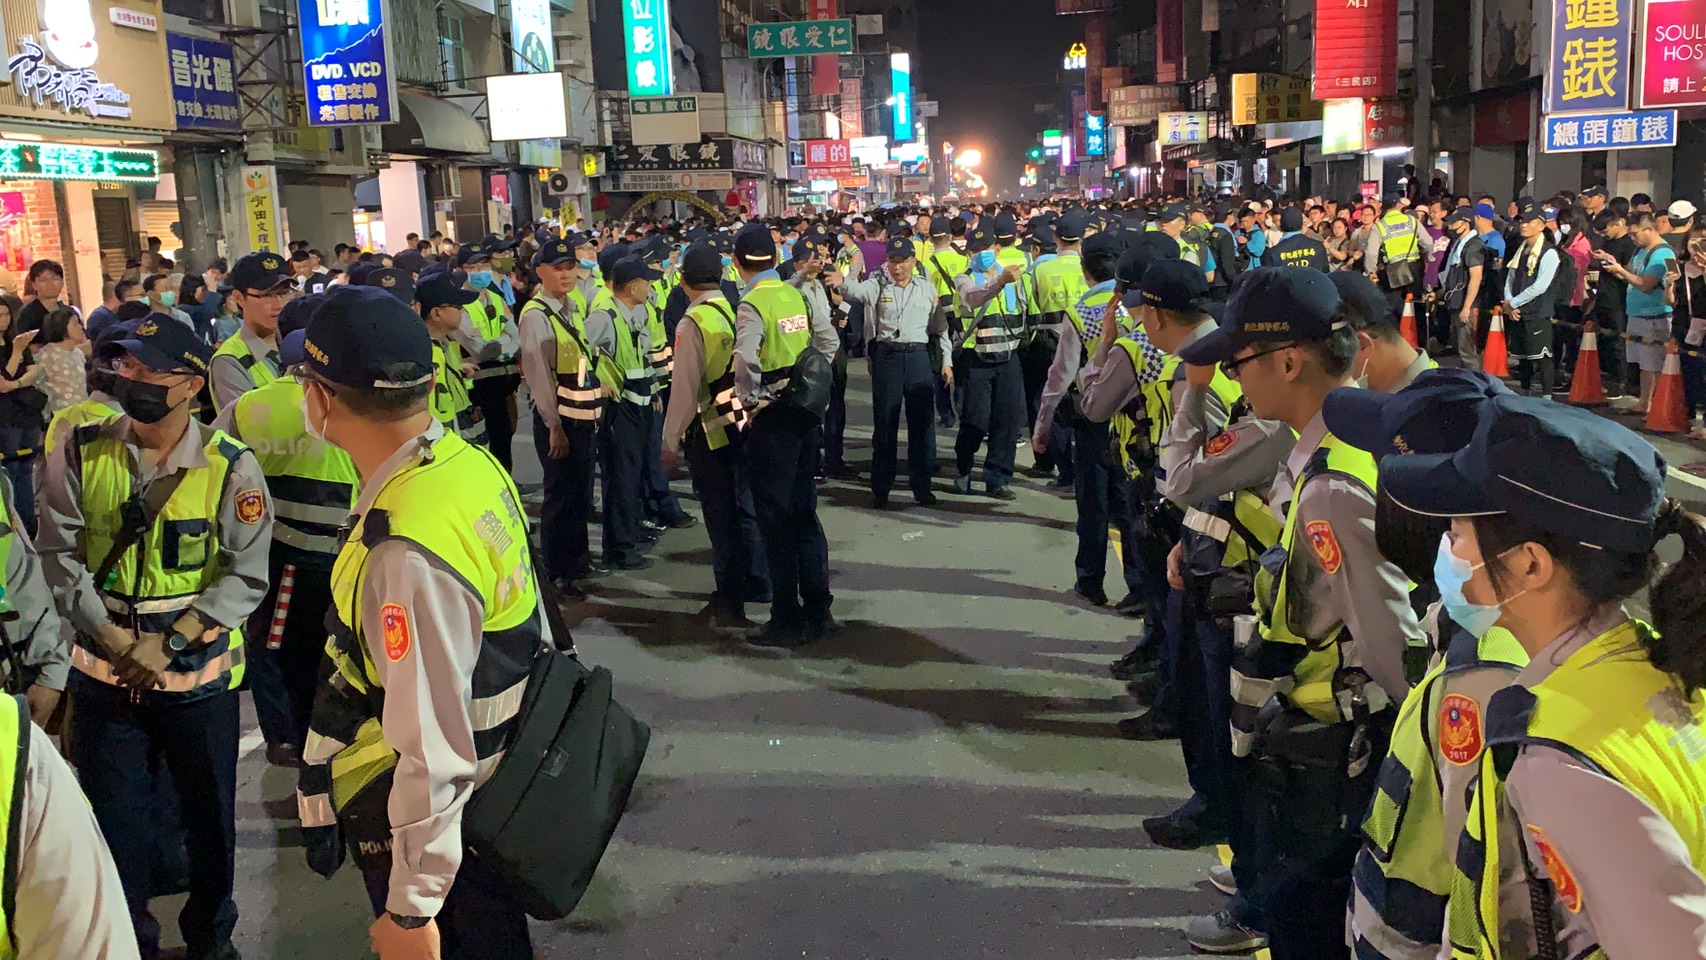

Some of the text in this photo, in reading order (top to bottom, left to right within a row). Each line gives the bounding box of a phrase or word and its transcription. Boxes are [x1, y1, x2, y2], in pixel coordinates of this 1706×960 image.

[1655, 24, 1706, 43] SOUL
[1663, 44, 1706, 62] HOS
[348, 61, 381, 78] VCD
[317, 83, 377, 101] 租售交換
[1663, 77, 1696, 94] 請上
[319, 103, 379, 121] 光碟製作
[634, 99, 694, 112] 電腦數位
[1086, 116, 1103, 151] 眼鏡
[1553, 116, 1668, 147] 總領鐘錶
[611, 142, 720, 161] 仁愛眼鏡
[811, 145, 847, 163] 麗的
